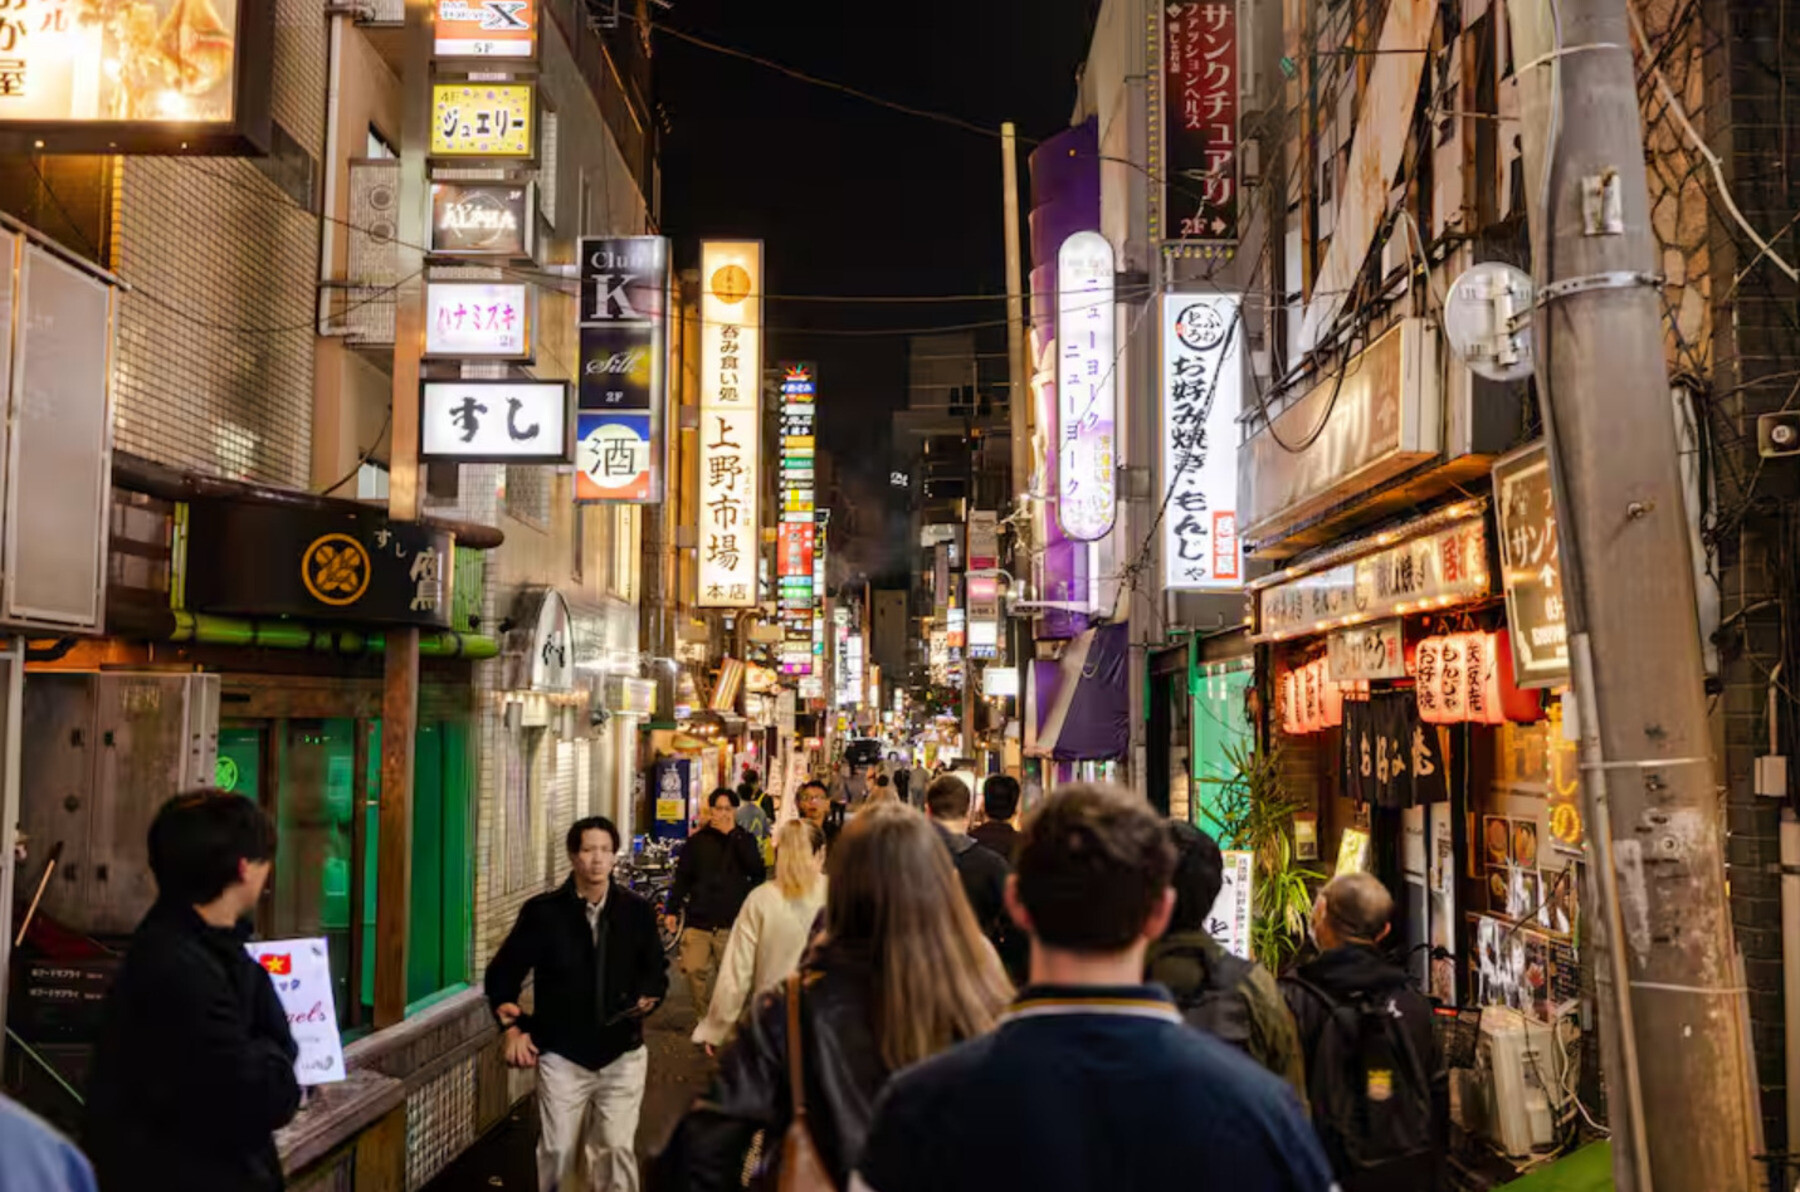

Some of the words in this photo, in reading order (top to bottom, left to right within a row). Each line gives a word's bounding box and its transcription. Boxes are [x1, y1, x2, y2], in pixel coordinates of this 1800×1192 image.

[443, 108, 524, 139] ジュエリー
[1202, 4, 1233, 205] サンクチュアリ
[1180, 218, 1206, 235] 2F
[436, 302, 518, 333] ハナミズキ
[590, 274, 641, 319] K
[720, 323, 739, 402] 呑み食い処
[1081, 278, 1101, 430] ニューヨーク
[605, 391, 624, 403] 2F
[449, 396, 540, 443] すし
[1064, 344, 1081, 496] ニューヨーク
[590, 437, 638, 477] 酒
[706, 416, 743, 572] 上野市場
[373, 529, 407, 558] すし
[706, 583, 747, 601] 本店
